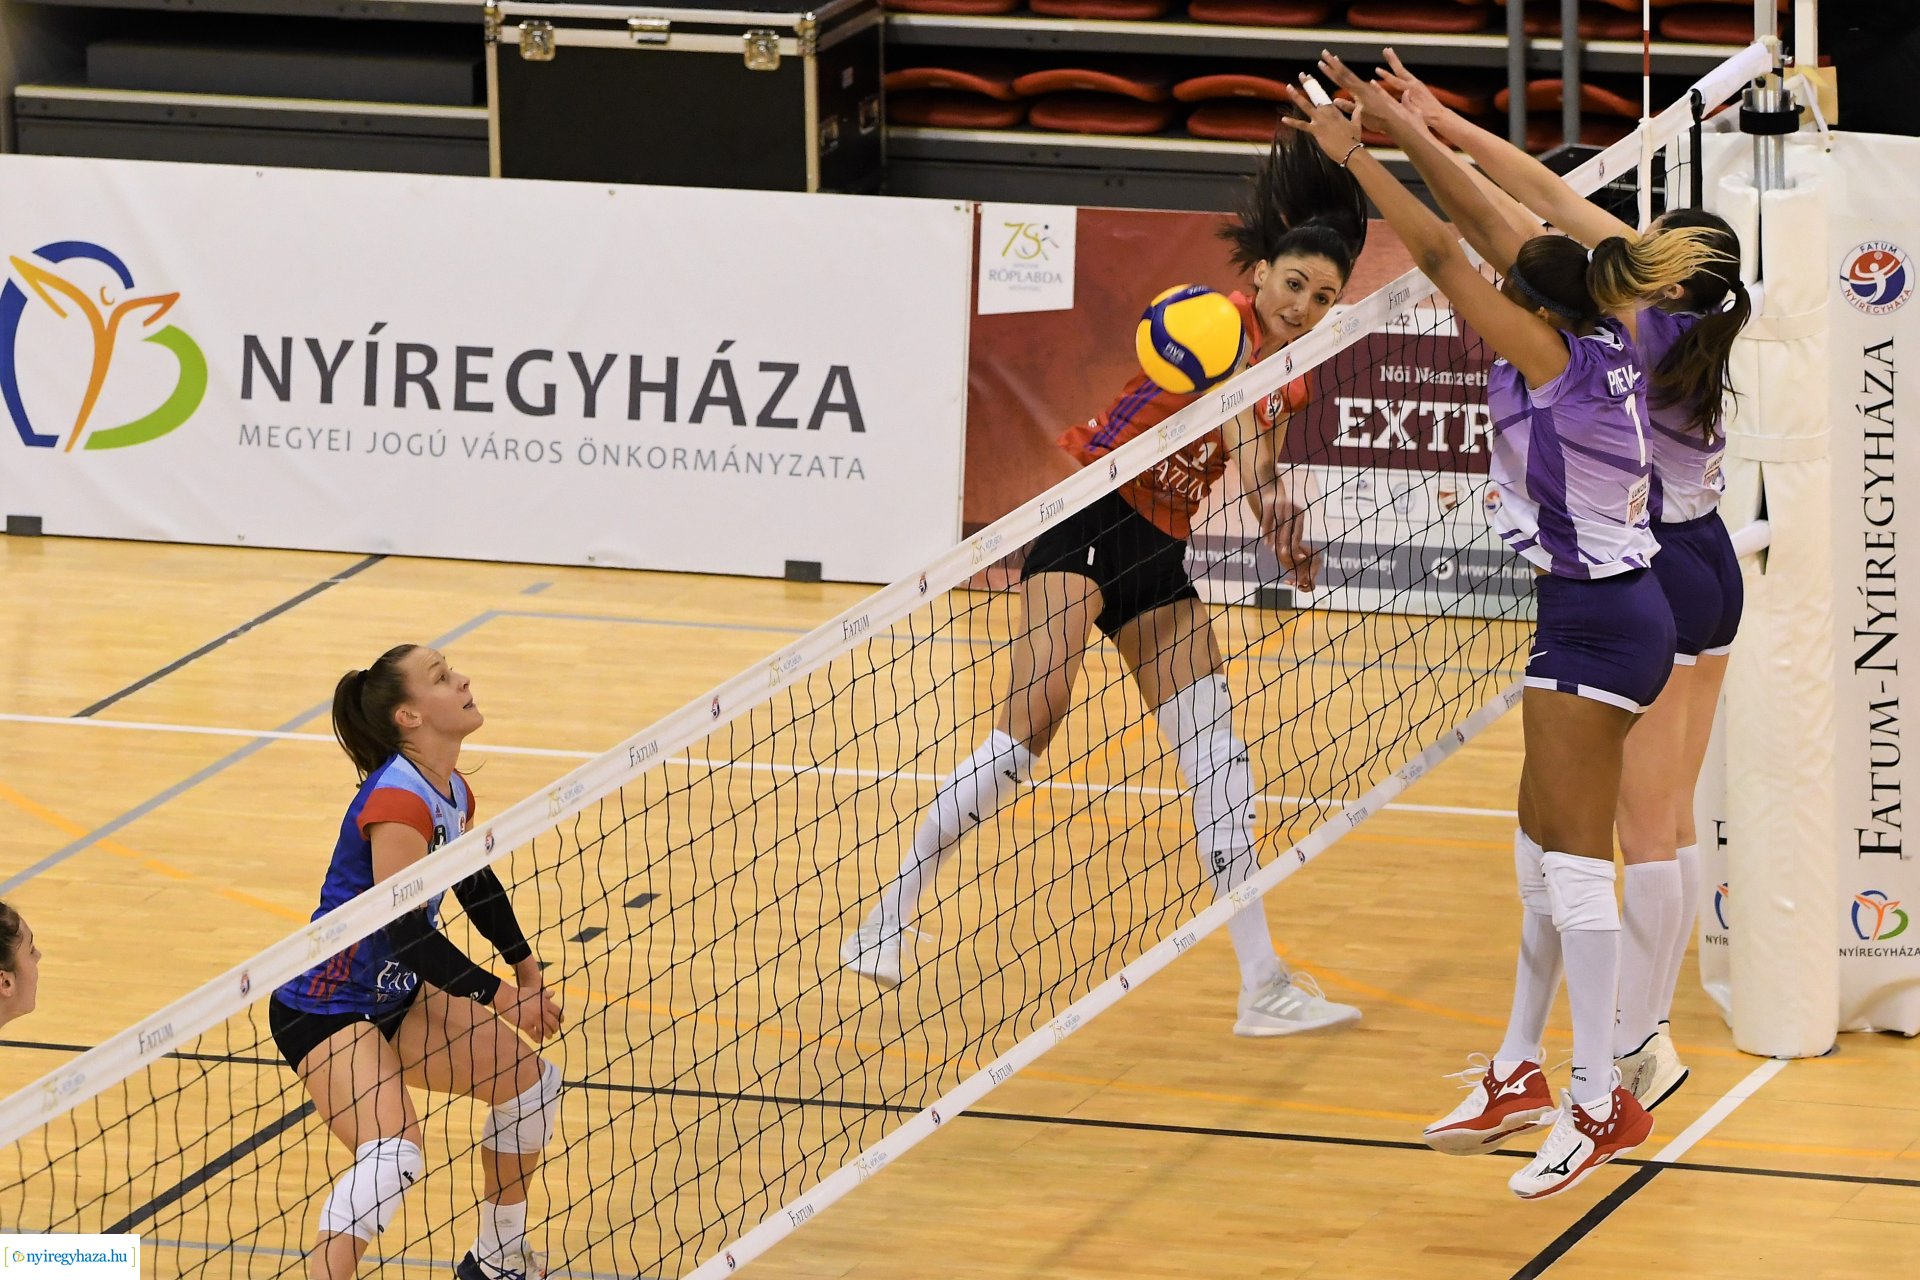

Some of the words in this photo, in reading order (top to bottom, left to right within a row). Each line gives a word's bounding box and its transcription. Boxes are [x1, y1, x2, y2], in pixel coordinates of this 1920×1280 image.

[1859, 242, 1898, 254] FATUM
[240, 321, 867, 434] NYÍREGYHÁZA
[1414, 365, 1488, 387] Nemzeti
[1607, 364, 1641, 396] PREV
[1220, 389, 1245, 413] FATUM
[1332, 396, 1495, 454] EXTR
[1624, 392, 1646, 468] 1
[239, 424, 352, 454] MEGYEI
[366, 428, 447, 458] JOGÚ
[462, 431, 564, 465] VÁROS
[578, 439, 867, 481] ÖNKORMÁNYZATA
[1146, 459, 1206, 501] ATUM
[1039, 498, 1065, 524] FATUM
[842, 614, 870, 641] FATUM
[629, 740, 659, 768] FATUM
[1346, 807, 1369, 827] FATUM
[391, 878, 424, 908] FATUM
[1172, 932, 1197, 953] FATUM
[138, 1022, 175, 1055] FATUM
[987, 1062, 1014, 1085] FATUM
[787, 1203, 815, 1229] FATUM
